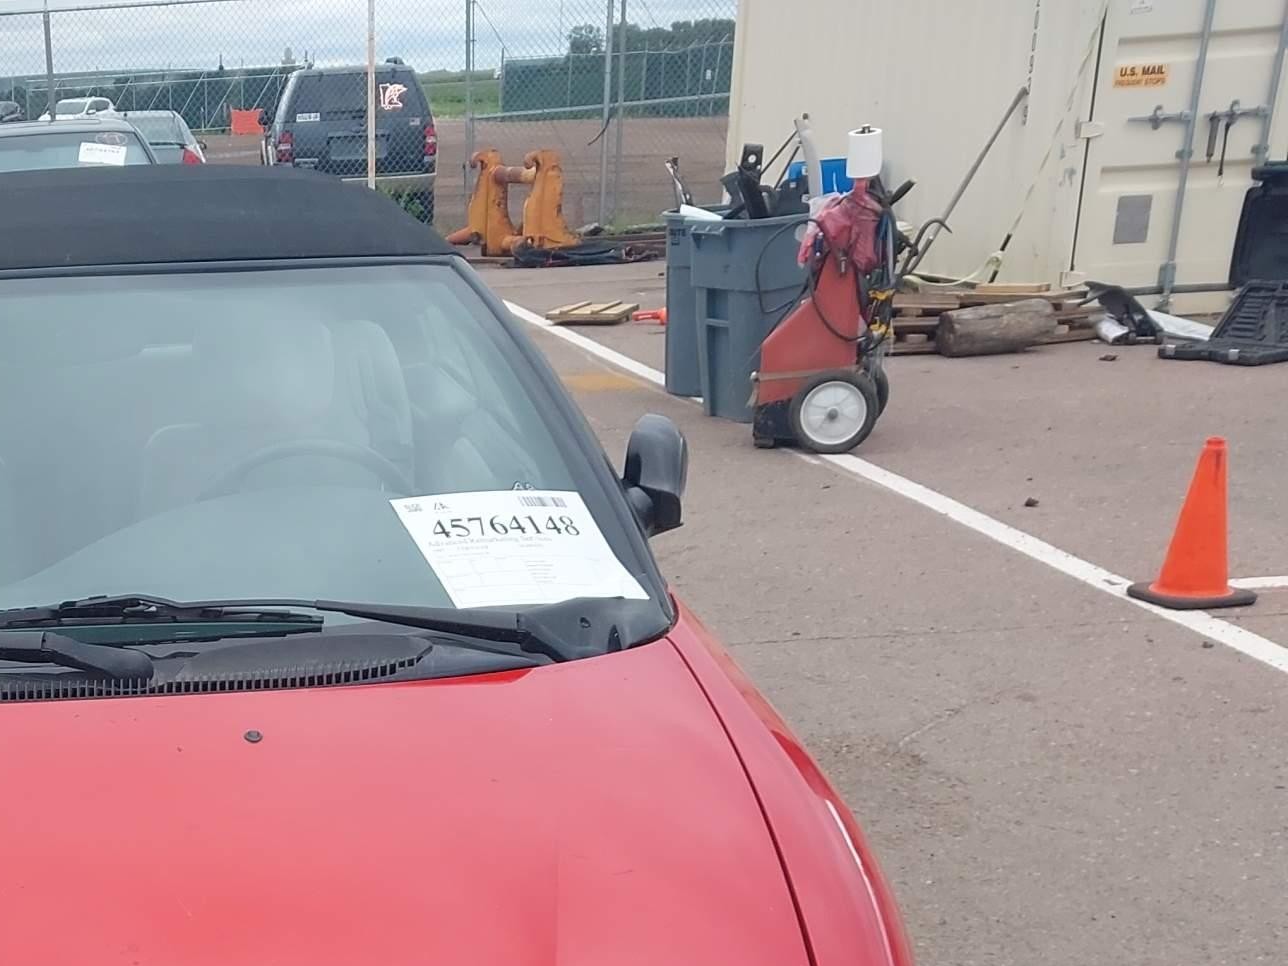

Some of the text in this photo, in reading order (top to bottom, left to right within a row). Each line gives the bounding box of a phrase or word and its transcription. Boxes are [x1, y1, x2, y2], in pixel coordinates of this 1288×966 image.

[1119, 65, 1165, 77] U.S. MAIL
[433, 515, 580, 538] 45764148
